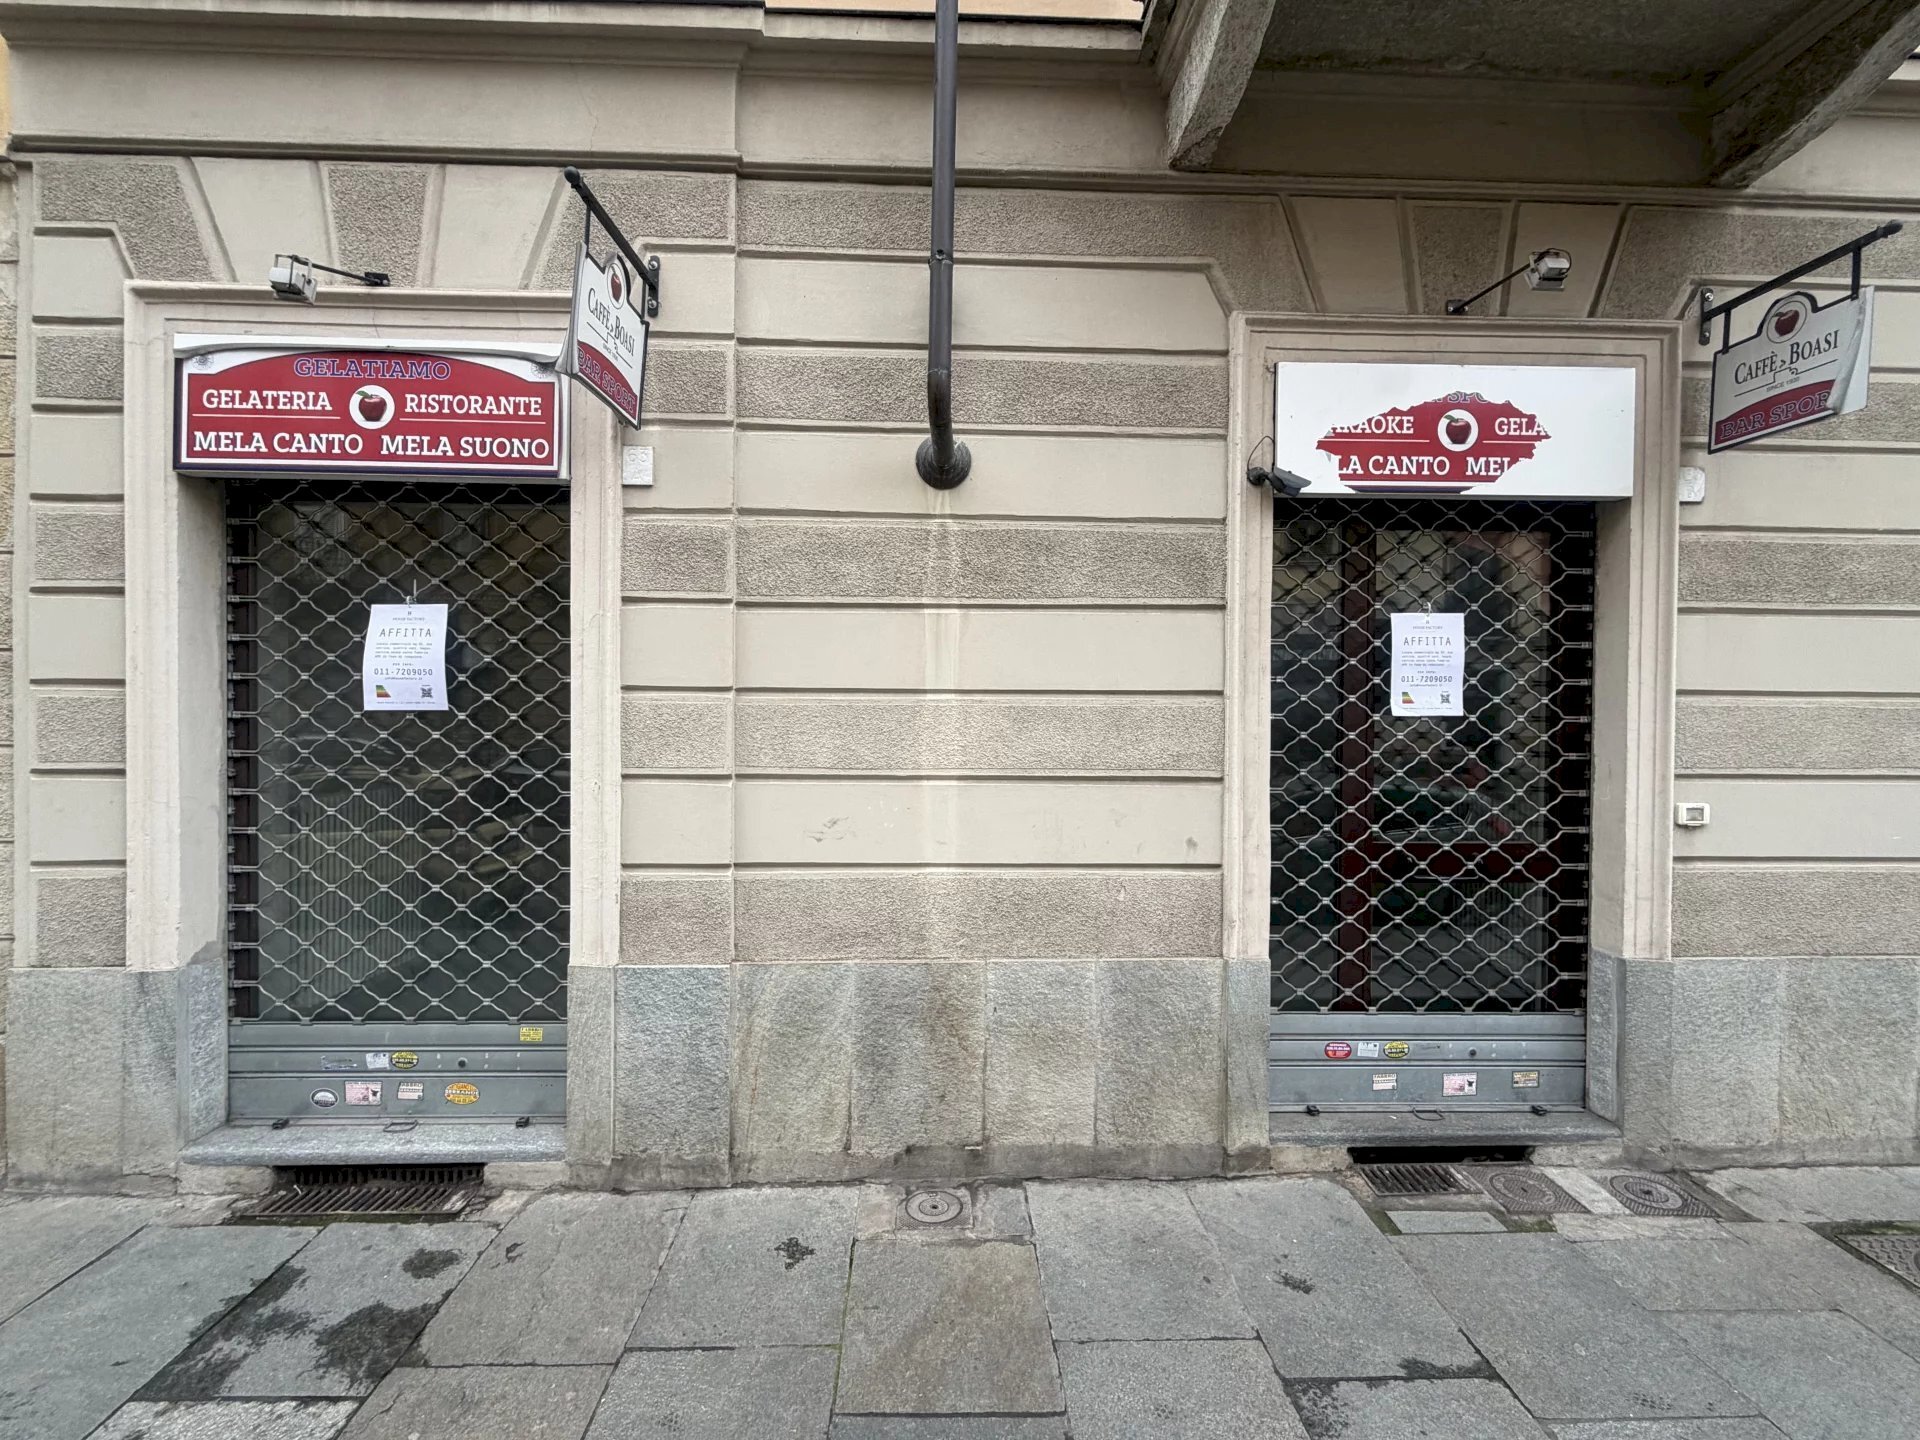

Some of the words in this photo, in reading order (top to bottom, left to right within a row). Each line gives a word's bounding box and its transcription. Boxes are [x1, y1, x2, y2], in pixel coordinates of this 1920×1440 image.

[587, 287, 611, 333] CAFFÈ
[614, 314, 636, 358] BOASI
[293, 357, 451, 382] GELATIAMO
[1734, 350, 1778, 385] CAFFÈ
[1789, 329, 1840, 366] BOASI
[577, 345, 602, 385] BAR
[601, 370, 636, 414] SPORT
[202, 389, 332, 412] GELATERIA
[404, 393, 542, 417] RISTORANTE
[1720, 413, 1765, 440] BAR
[193, 431, 268, 454] MELA
[273, 432, 364, 456] CANTO
[380, 434, 455, 458] MELA
[460, 436, 551, 460] SUONO
[1368, 455, 1450, 476] CANTO
[379, 627, 432, 638] AFFITTA
[1403, 636, 1452, 646] AFFITTA
[373, 667, 433, 676] 011-7209050
[1401, 675, 1453, 683] 011-7209050
